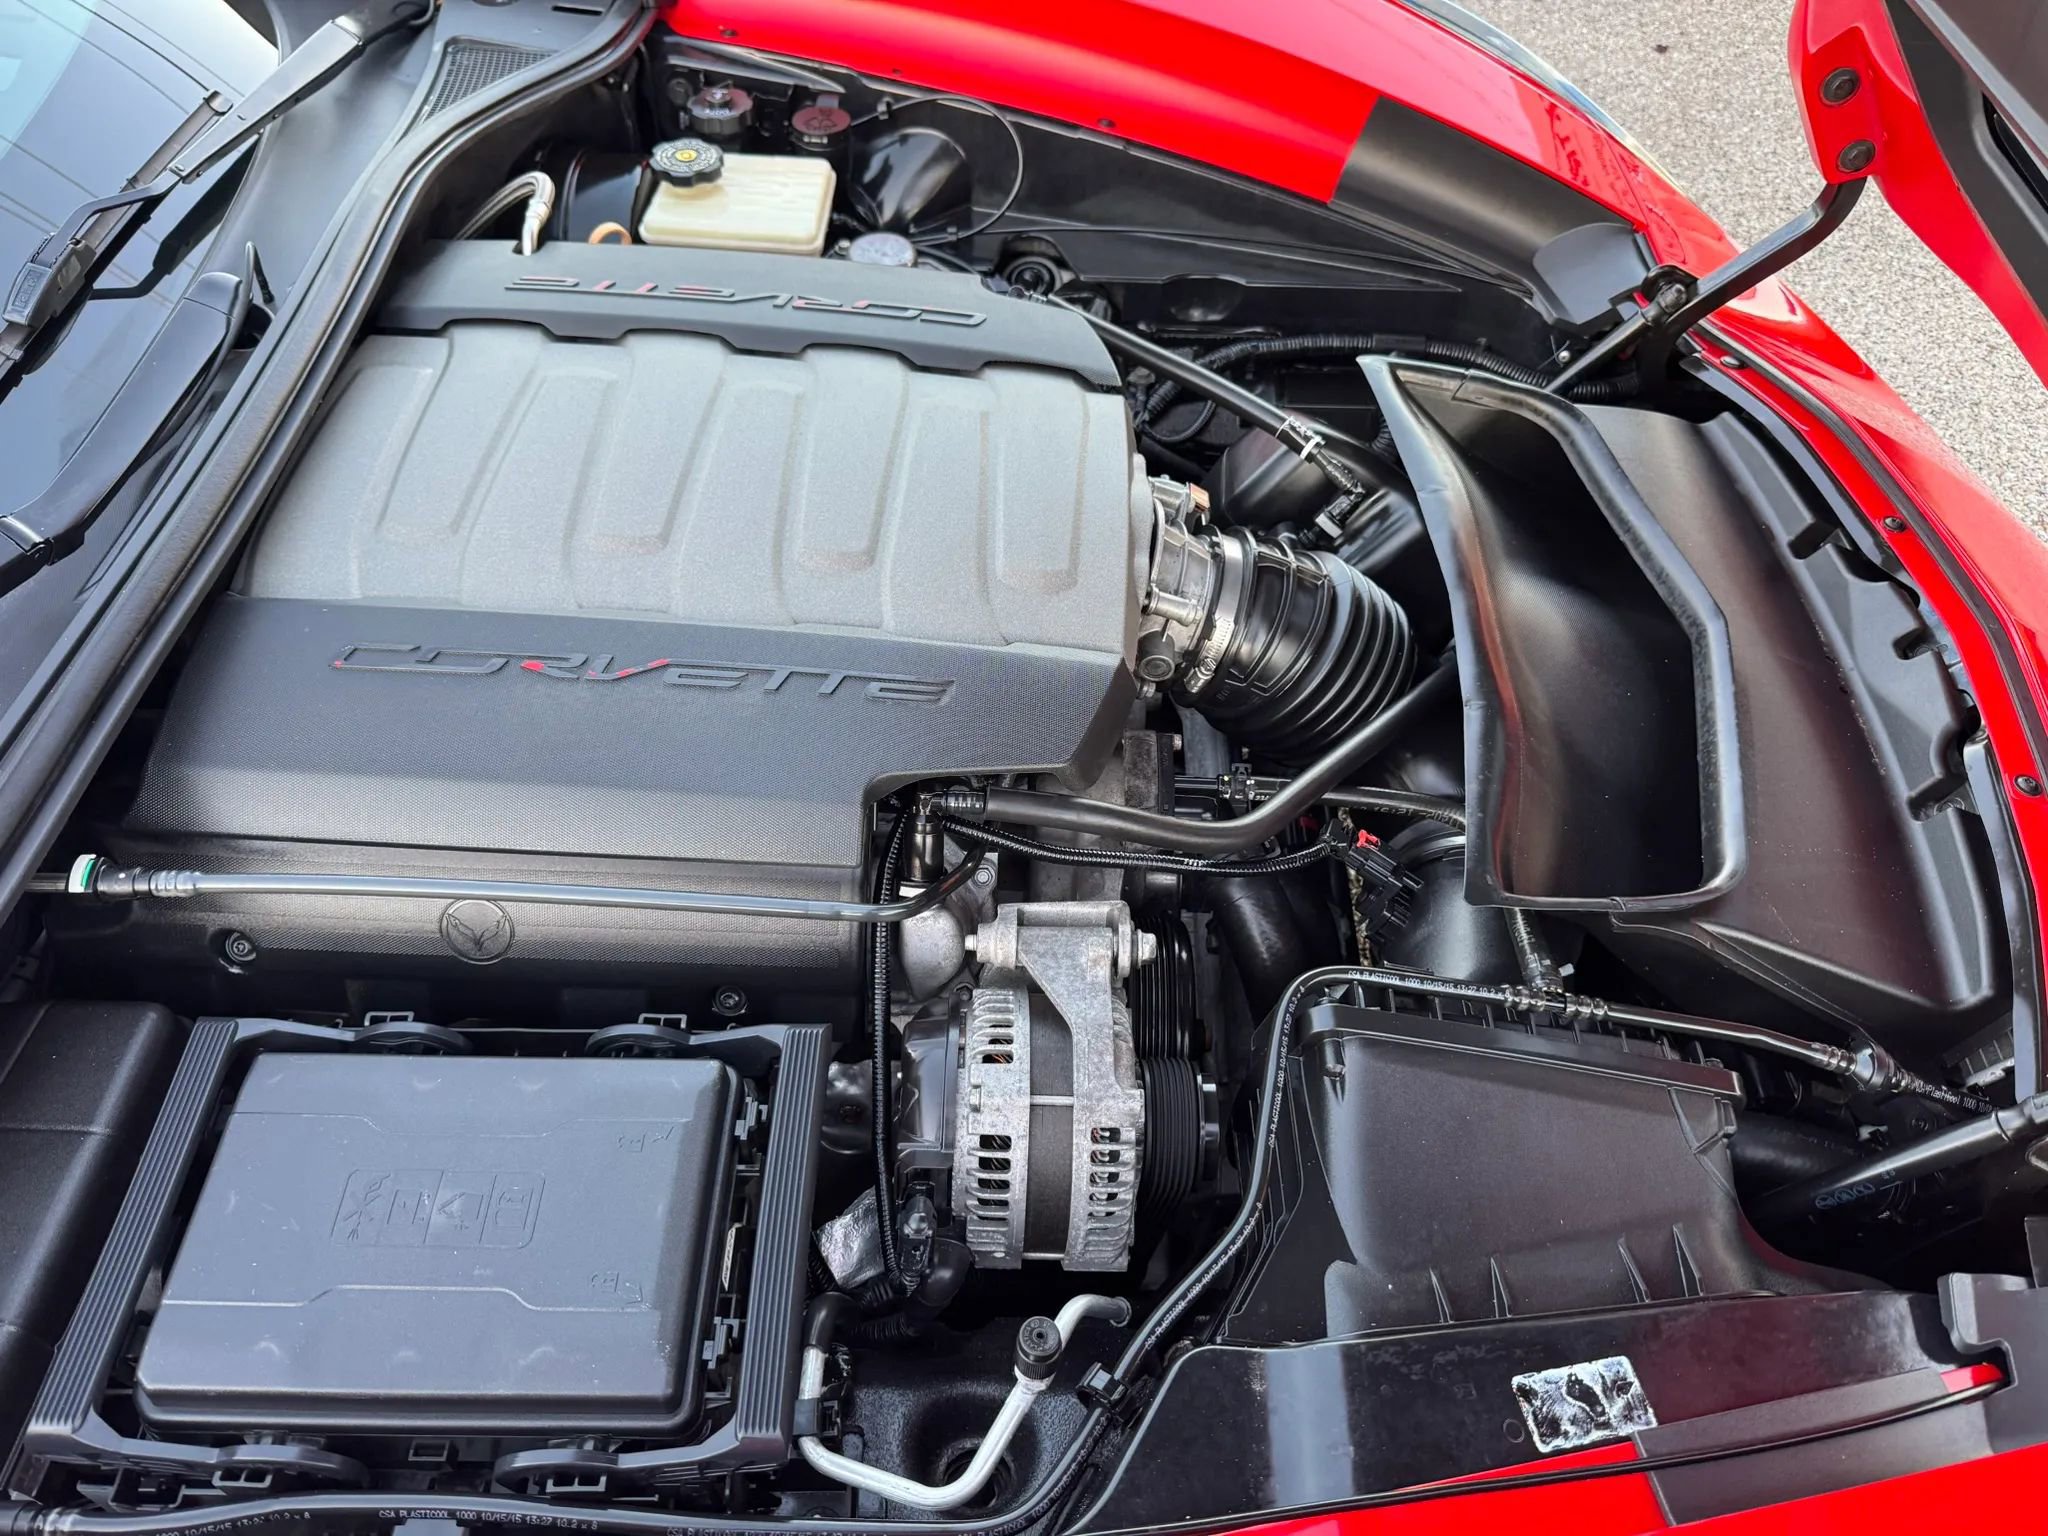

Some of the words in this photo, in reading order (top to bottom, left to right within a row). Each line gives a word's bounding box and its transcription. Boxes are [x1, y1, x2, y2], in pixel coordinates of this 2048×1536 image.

[504, 276, 988, 327] CORVETTE
[328, 643, 955, 704] CORVETTE
[1348, 969, 1361, 979] CSA
[1363, 971, 1401, 985] PLASTICOOL
[1405, 977, 1421, 986] 1000
[1423, 979, 1455, 992] 10/15/15
[1456, 983, 1477, 994] 13:27
[1479, 985, 1496, 996] 10.2
[1280, 1035, 1289, 1068] 10/15/15
[1277, 1069, 1285, 1088] 1000
[1270, 1091, 1283, 1133] PLASTICOOL
[1963, 1097, 1977, 1110] 1000
[1267, 1132, 1276, 1148] CSA
[184, 1521, 233, 1535] 10/15/15
[378, 1510, 396, 1518] CSA
[399, 1510, 450, 1519] PLASTICOOL
[455, 1510, 478, 1520] 1000
[480, 1511, 522, 1524] 10/15/15
[525, 1515, 552, 1526] 13:27
[556, 1517, 578, 1529] 10.2
